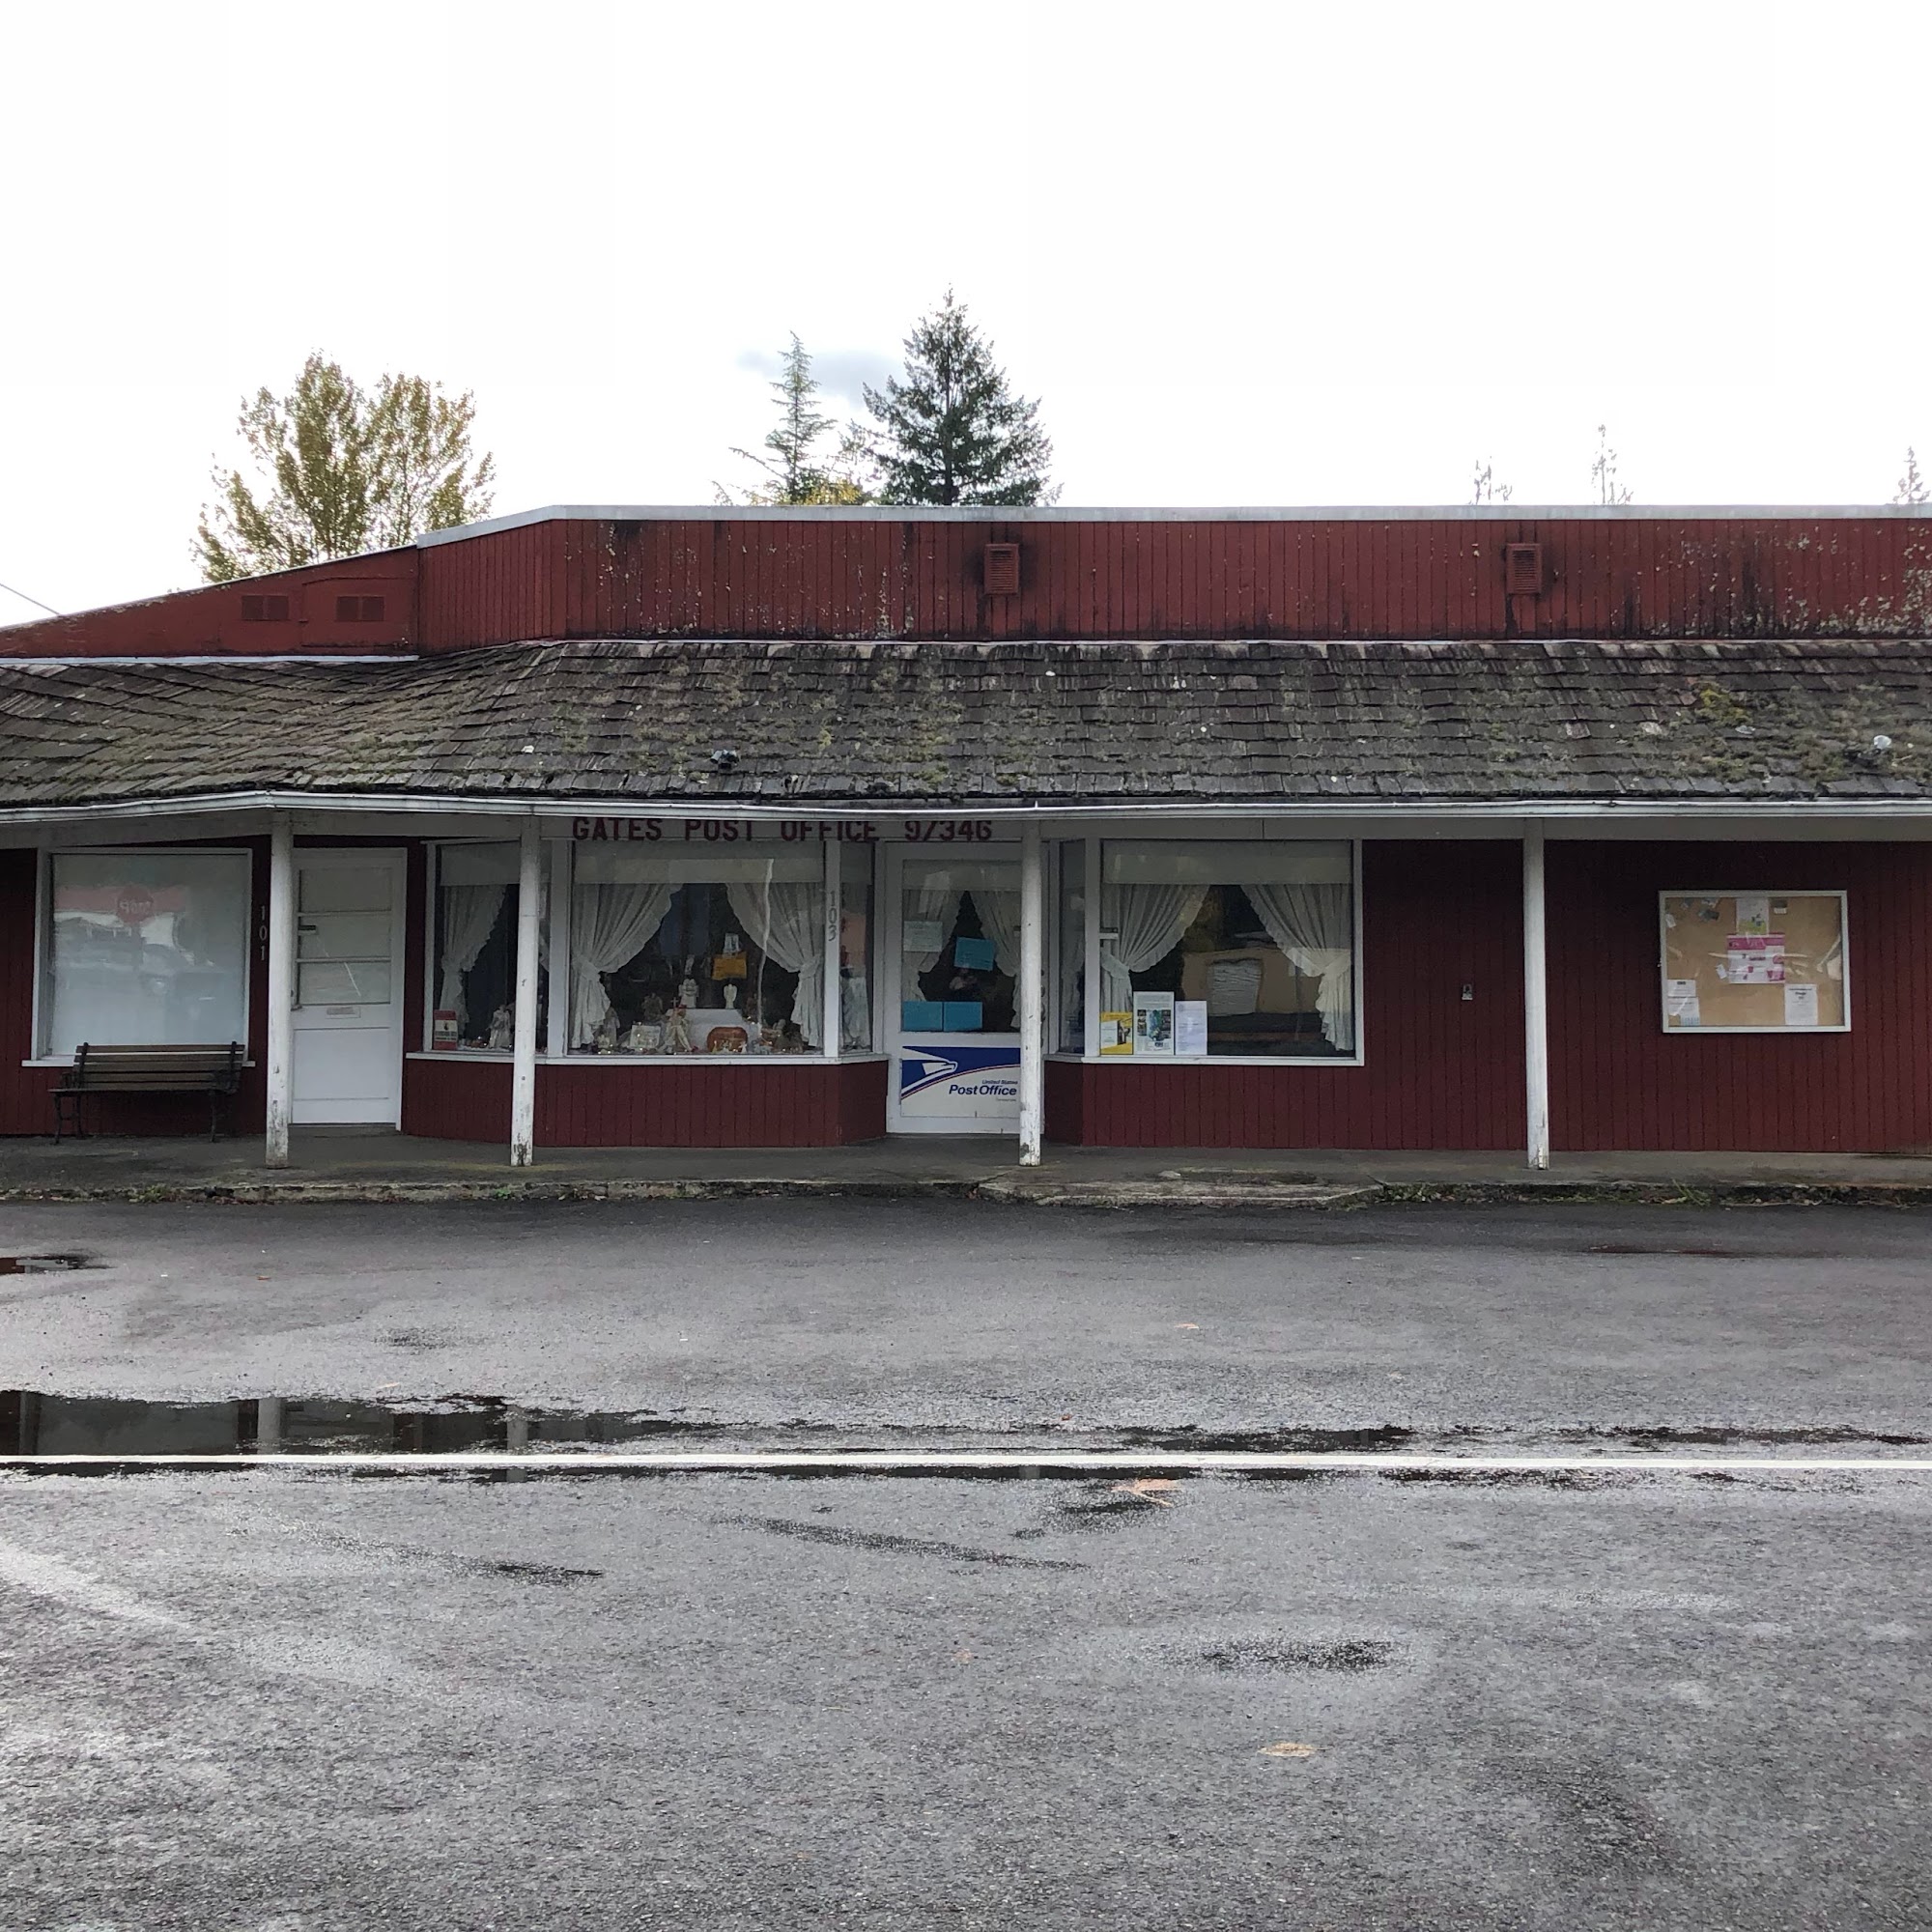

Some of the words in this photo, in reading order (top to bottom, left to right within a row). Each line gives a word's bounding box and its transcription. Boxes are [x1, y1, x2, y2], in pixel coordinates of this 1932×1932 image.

[572, 816, 662, 840] GATES
[685, 820, 752, 841] POST
[780, 821, 880, 841] OFFICE
[259, 905, 268, 961] 101
[828, 890, 838, 942] 103
[949, 1084, 979, 1095] Post
[980, 1085, 1017, 1095] Office
